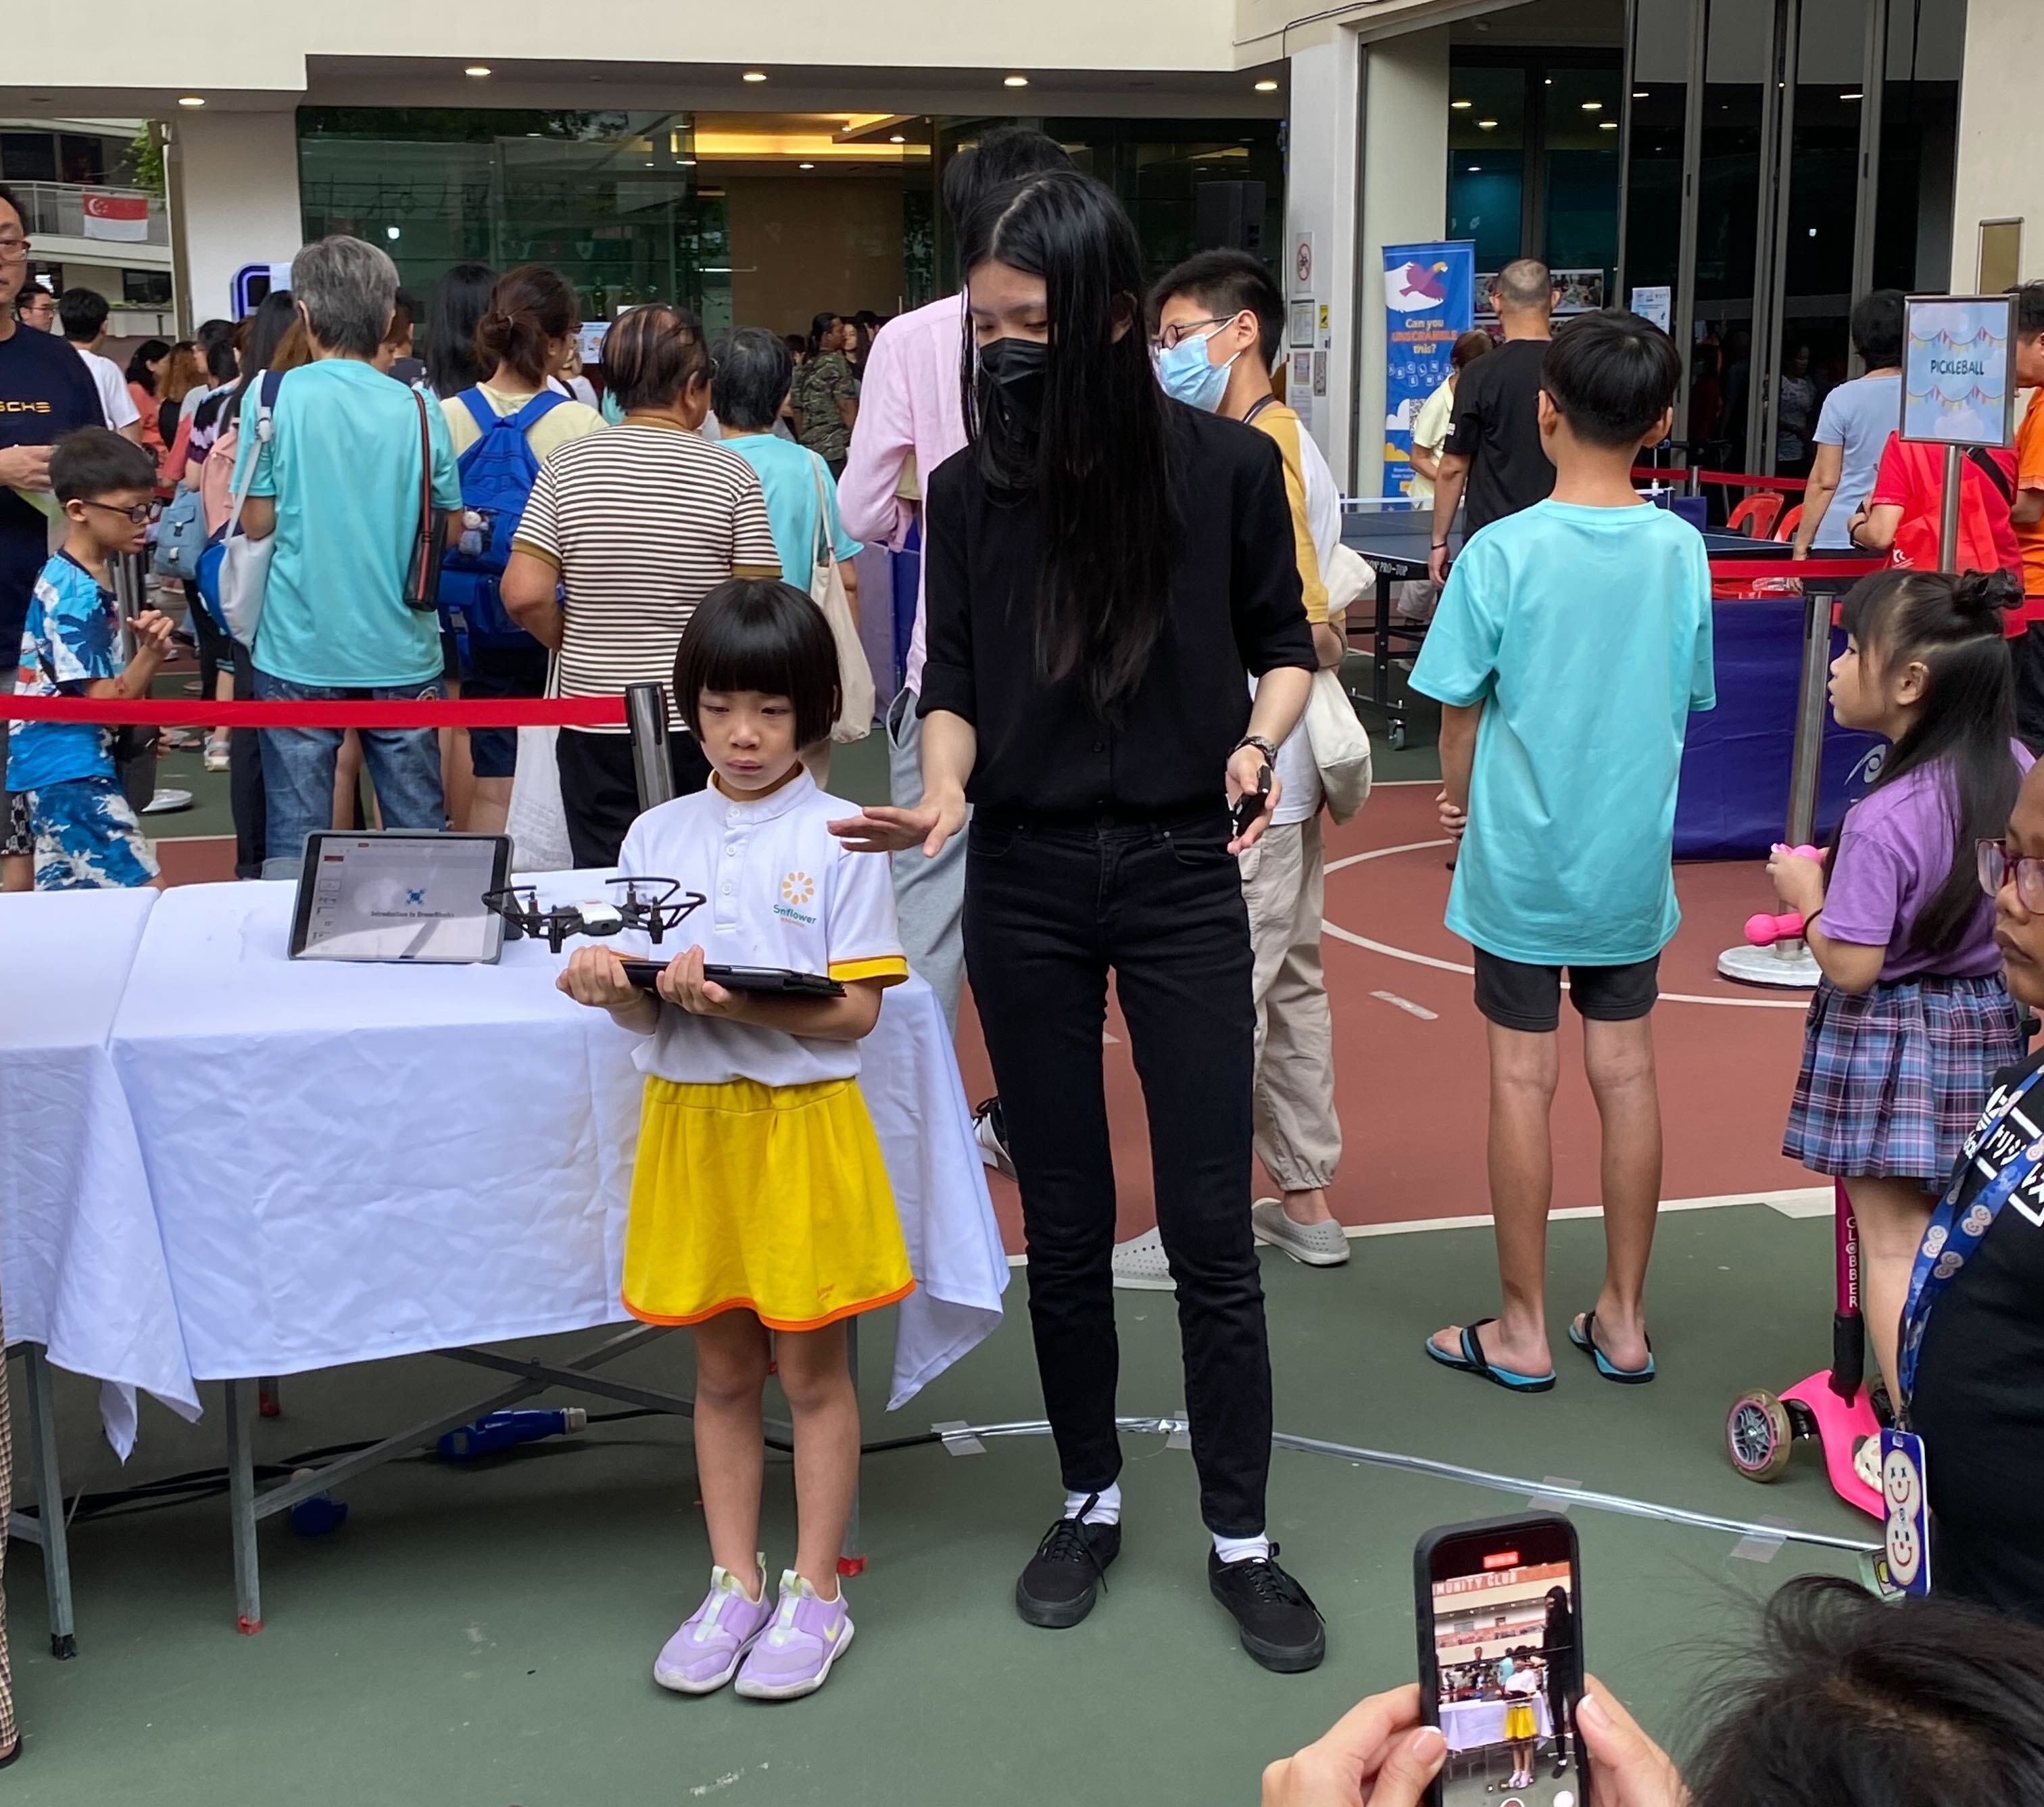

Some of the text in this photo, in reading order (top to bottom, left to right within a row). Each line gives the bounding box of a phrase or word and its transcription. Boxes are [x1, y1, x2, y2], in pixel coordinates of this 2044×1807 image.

[1405, 318, 1444, 332] Can you
[1930, 360, 1984, 375] PICKLEBALL
[773, 904, 817, 924] Snflower
[1845, 1217, 1857, 1308] GLOBBER
